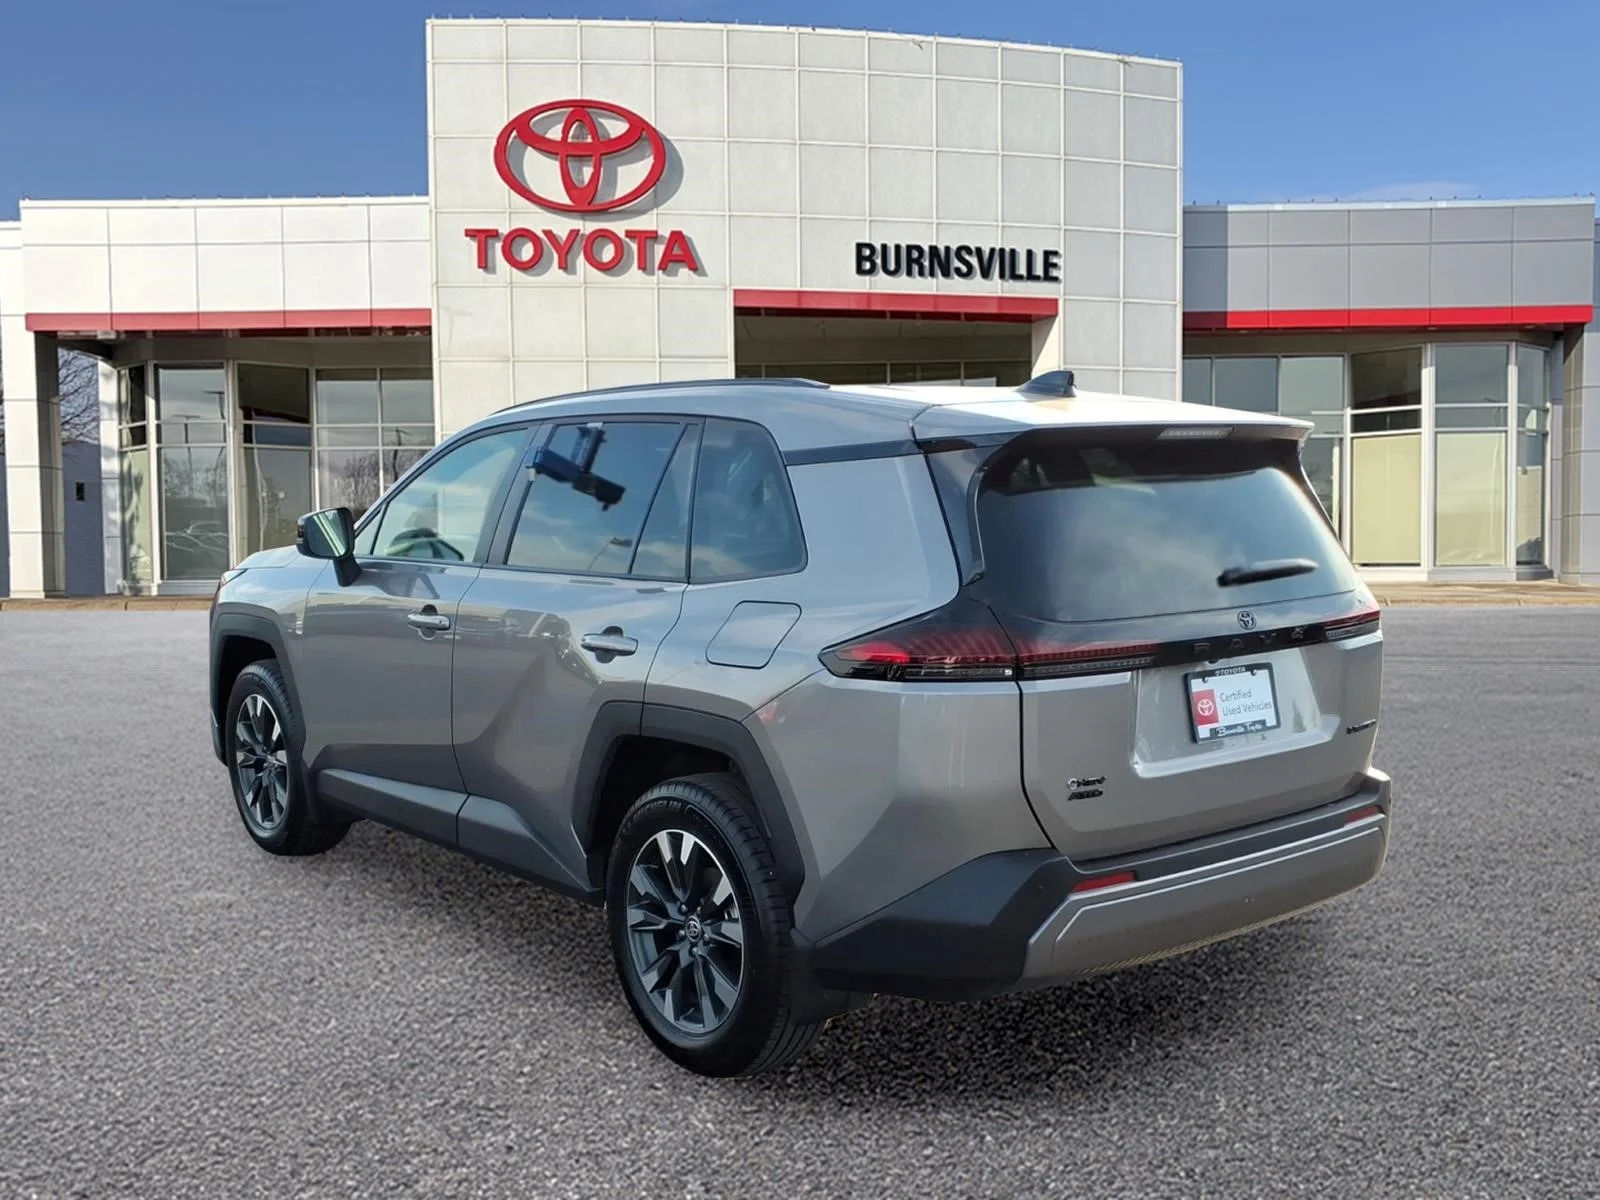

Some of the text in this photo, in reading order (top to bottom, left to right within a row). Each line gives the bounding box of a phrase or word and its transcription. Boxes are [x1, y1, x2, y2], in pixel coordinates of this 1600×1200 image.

[464, 228, 699, 272] TOYOTA
[855, 242, 1062, 283] BURNSVILLE
[1221, 666, 1247, 676] TOYOTA
[1219, 688, 1252, 703] Certified
[1222, 700, 1273, 717] Used Vehicles
